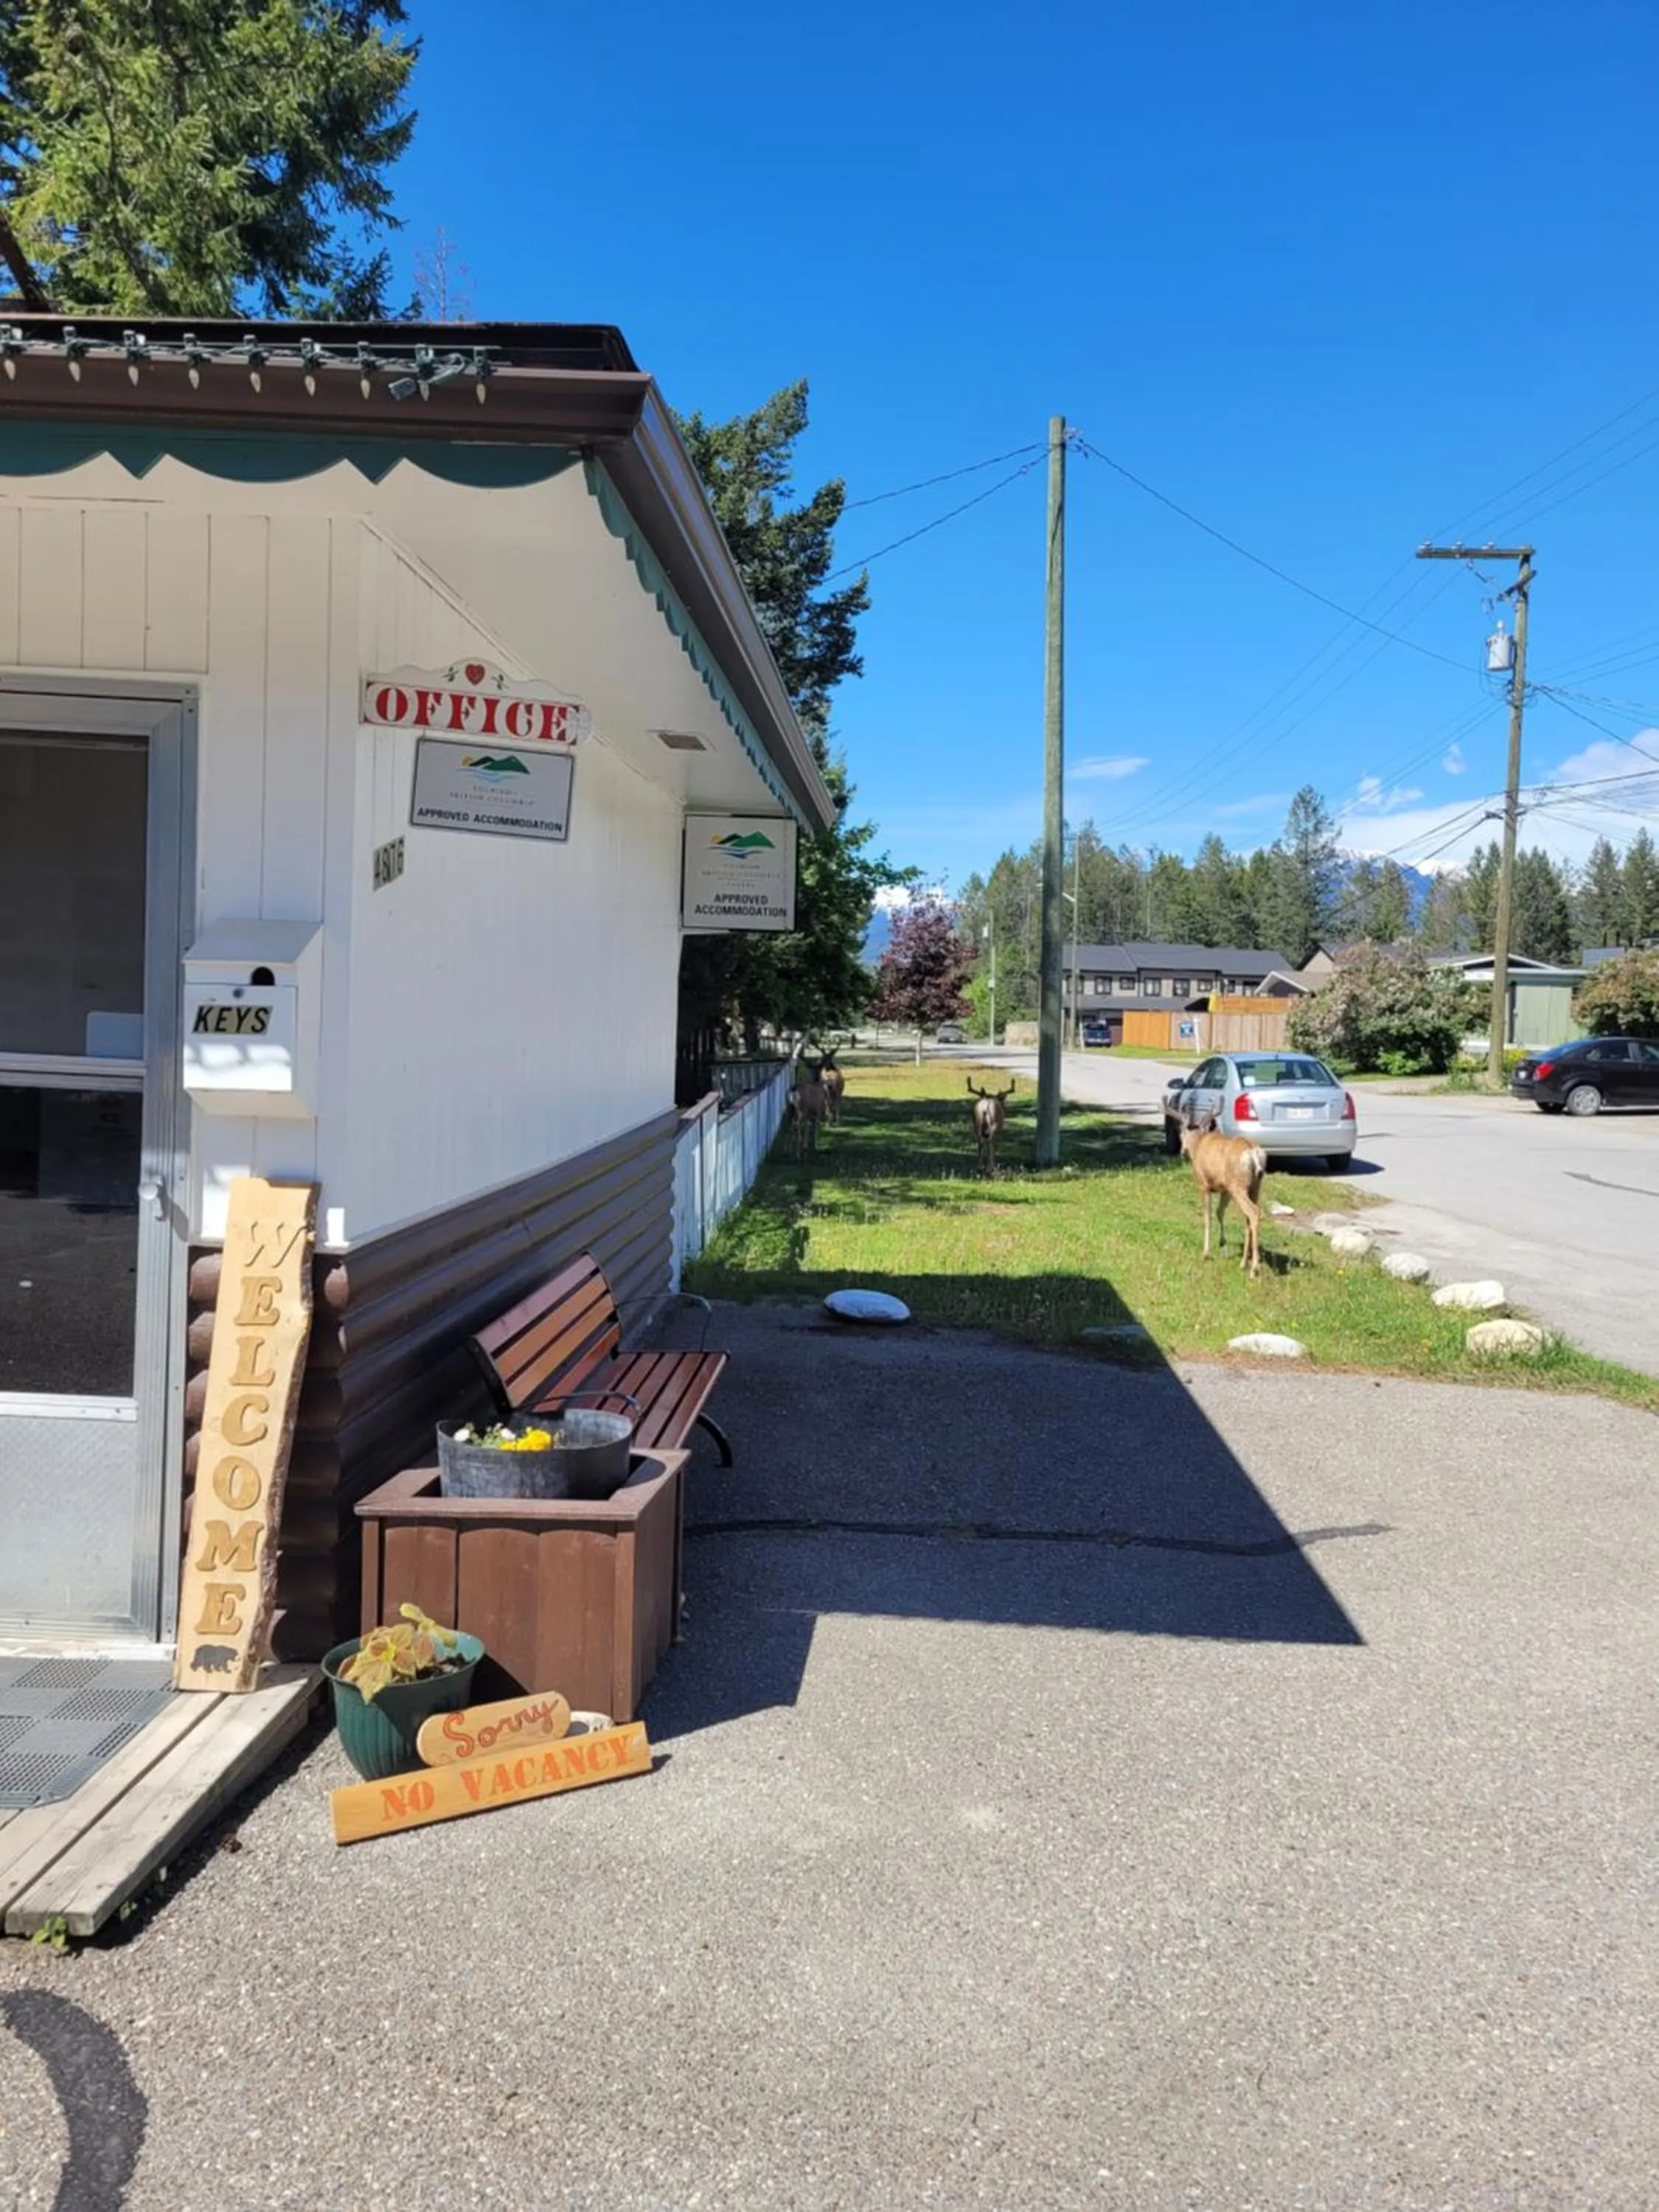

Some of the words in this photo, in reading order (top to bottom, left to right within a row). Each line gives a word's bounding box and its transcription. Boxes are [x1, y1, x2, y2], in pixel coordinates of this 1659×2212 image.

[375, 686, 568, 742] OFFICE
[417, 807, 470, 823] APPROVED
[473, 813, 563, 832] ACCOMMODATION
[695, 904, 787, 917] ACCOMMODATION
[714, 894, 768, 905] APPROVED
[192, 1006, 270, 1034] KEYS
[195, 1219, 311, 1637] WELCOME
[442, 1698, 559, 1759] Sorry
[380, 1780, 435, 1821] NO
[459, 1733, 636, 1801] VACANCY
